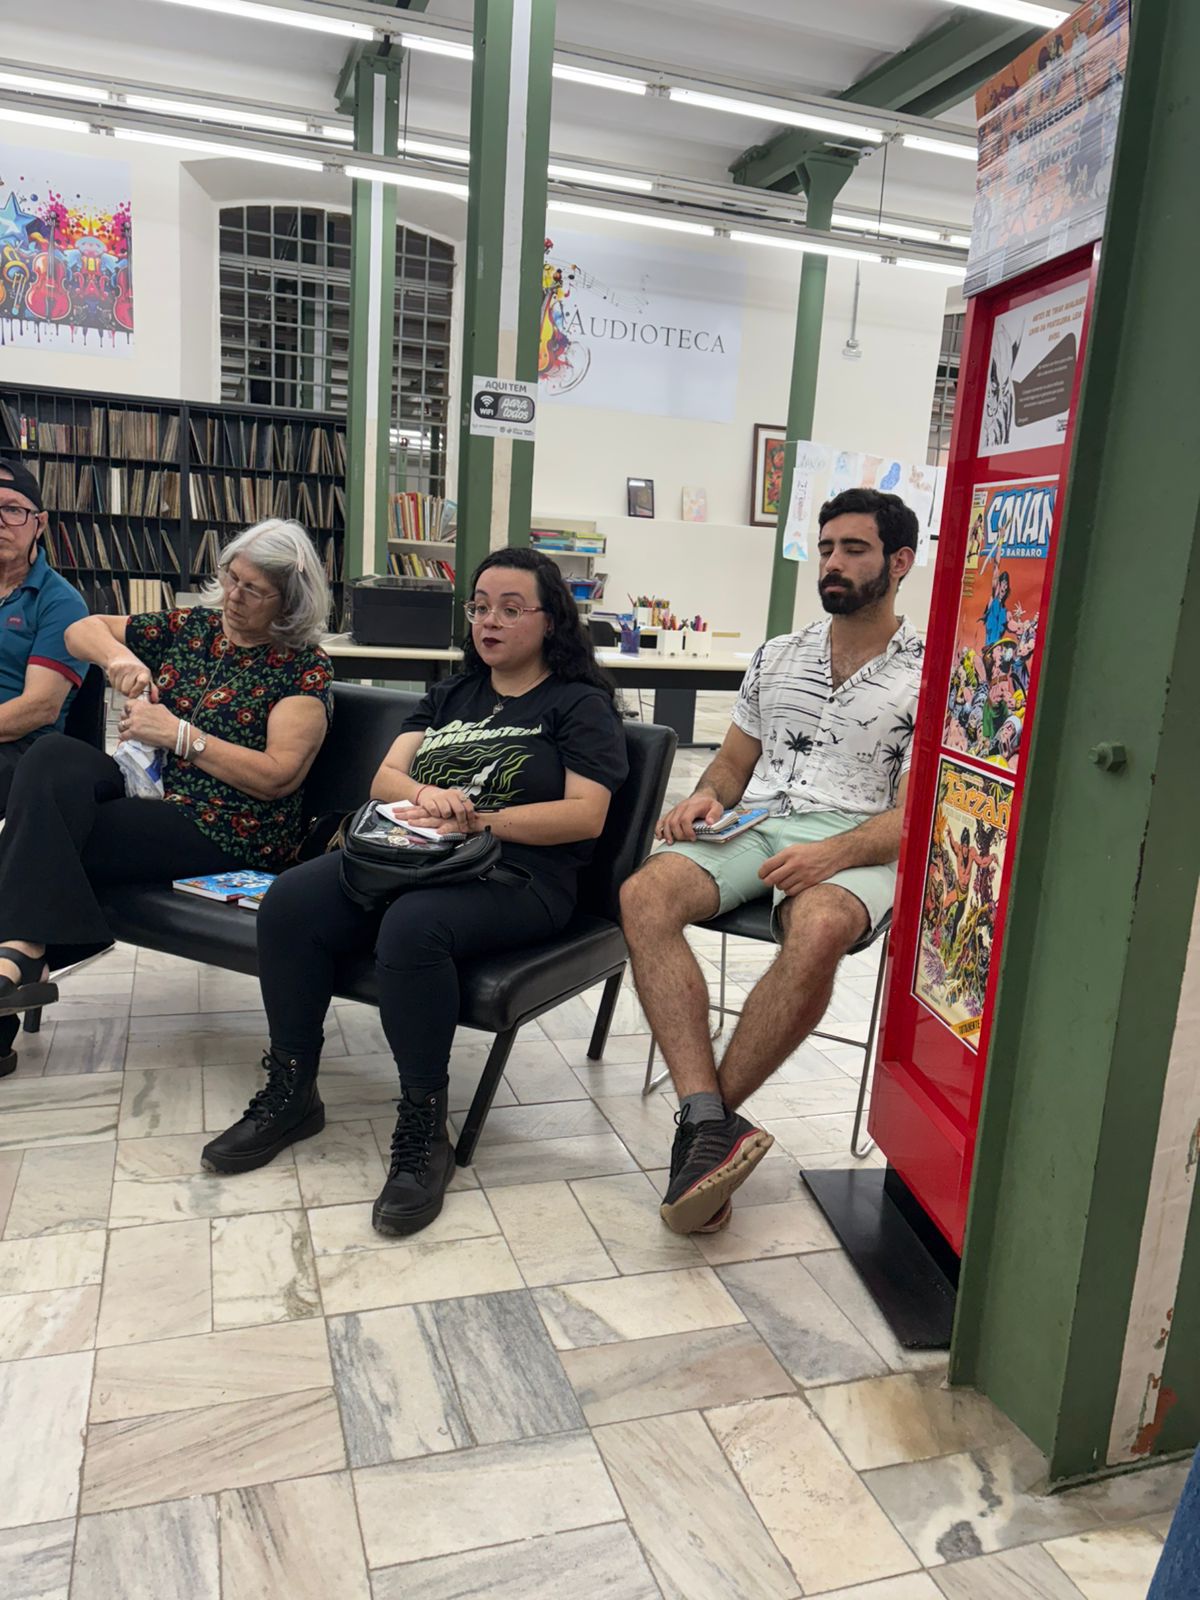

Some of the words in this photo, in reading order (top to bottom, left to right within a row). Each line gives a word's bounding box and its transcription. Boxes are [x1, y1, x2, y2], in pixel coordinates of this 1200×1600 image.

[567, 309, 726, 354] AUDIOTECA
[485, 381, 507, 391] AQUI
[508, 383, 527, 393] TEM
[500, 398, 528, 409] para
[502, 408, 529, 420] todos
[987, 488, 1057, 545] CONAN
[943, 769, 1010, 832] Tarzan
